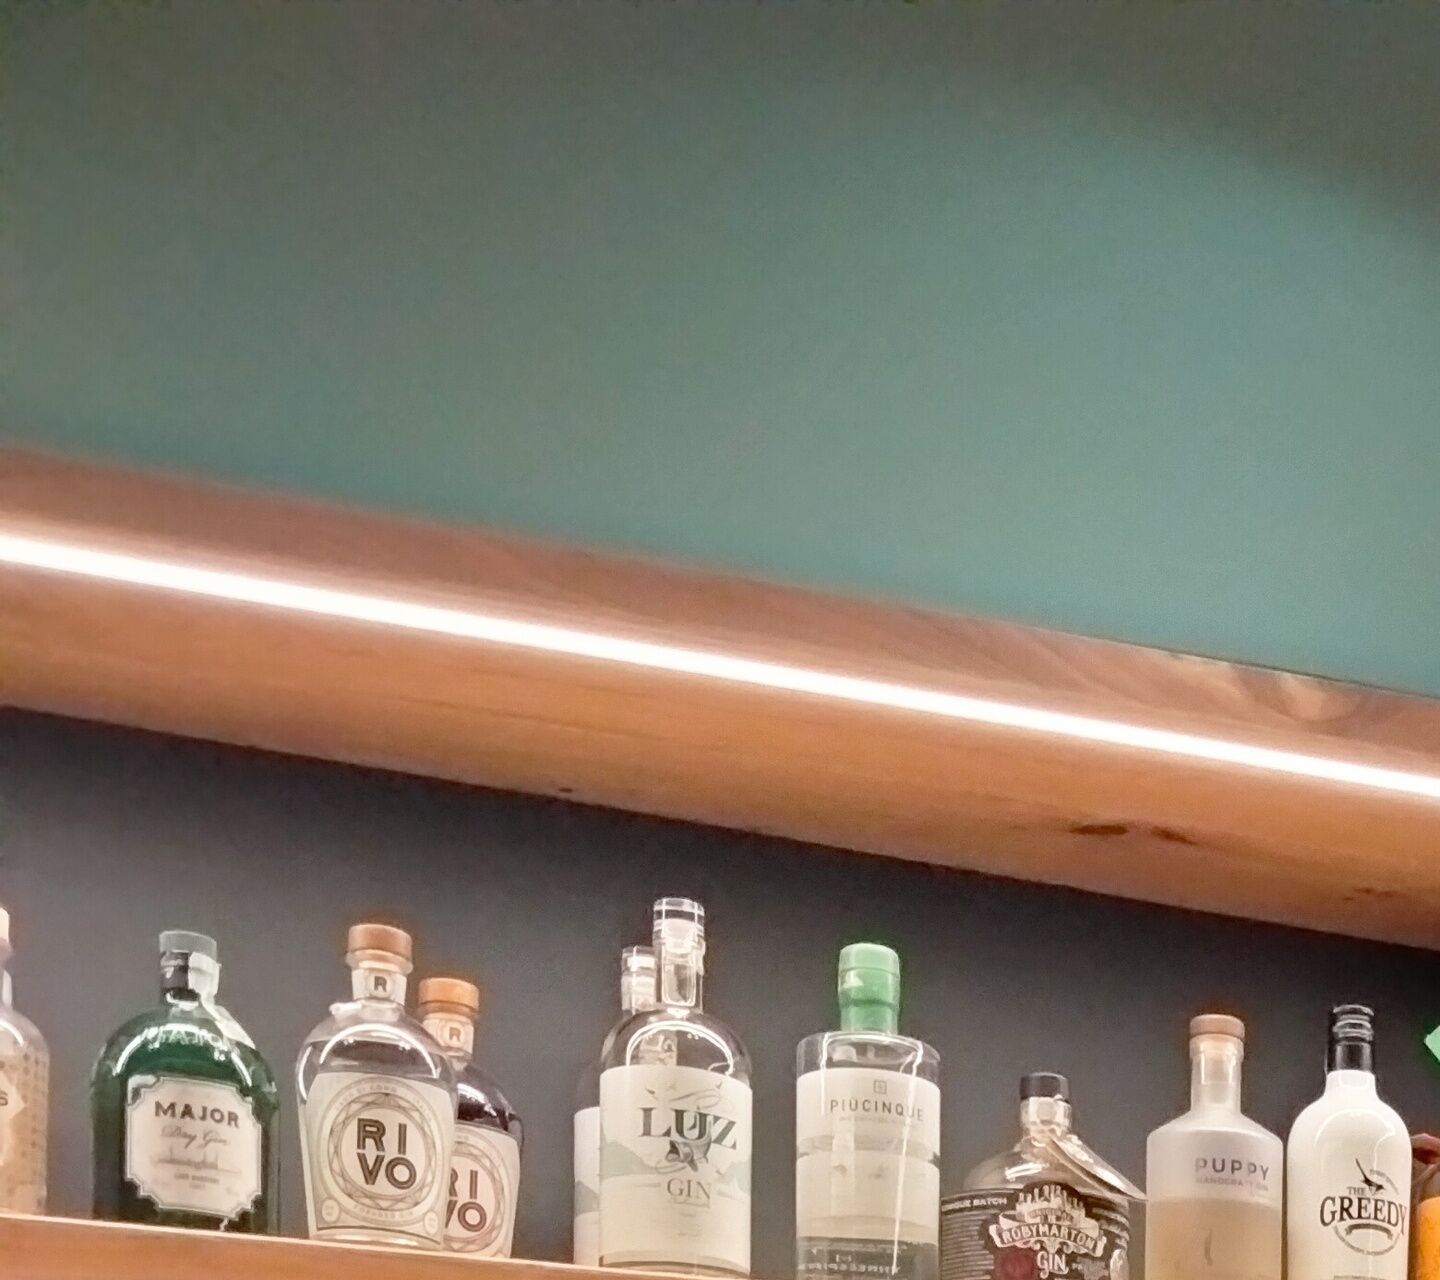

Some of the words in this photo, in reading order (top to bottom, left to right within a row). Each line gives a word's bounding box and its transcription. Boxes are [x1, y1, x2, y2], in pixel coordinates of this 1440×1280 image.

[154, 1100, 240, 1129] MAJOR
[638, 1107, 737, 1150] LUZ
[1195, 1157, 1269, 1180] PUPPY
[667, 1177, 711, 1200] GIN
[1320, 1196, 1407, 1236] GREEDY
[1002, 1224, 1098, 1250] ROBYMARTON
[1036, 1251, 1068, 1279] GIN
